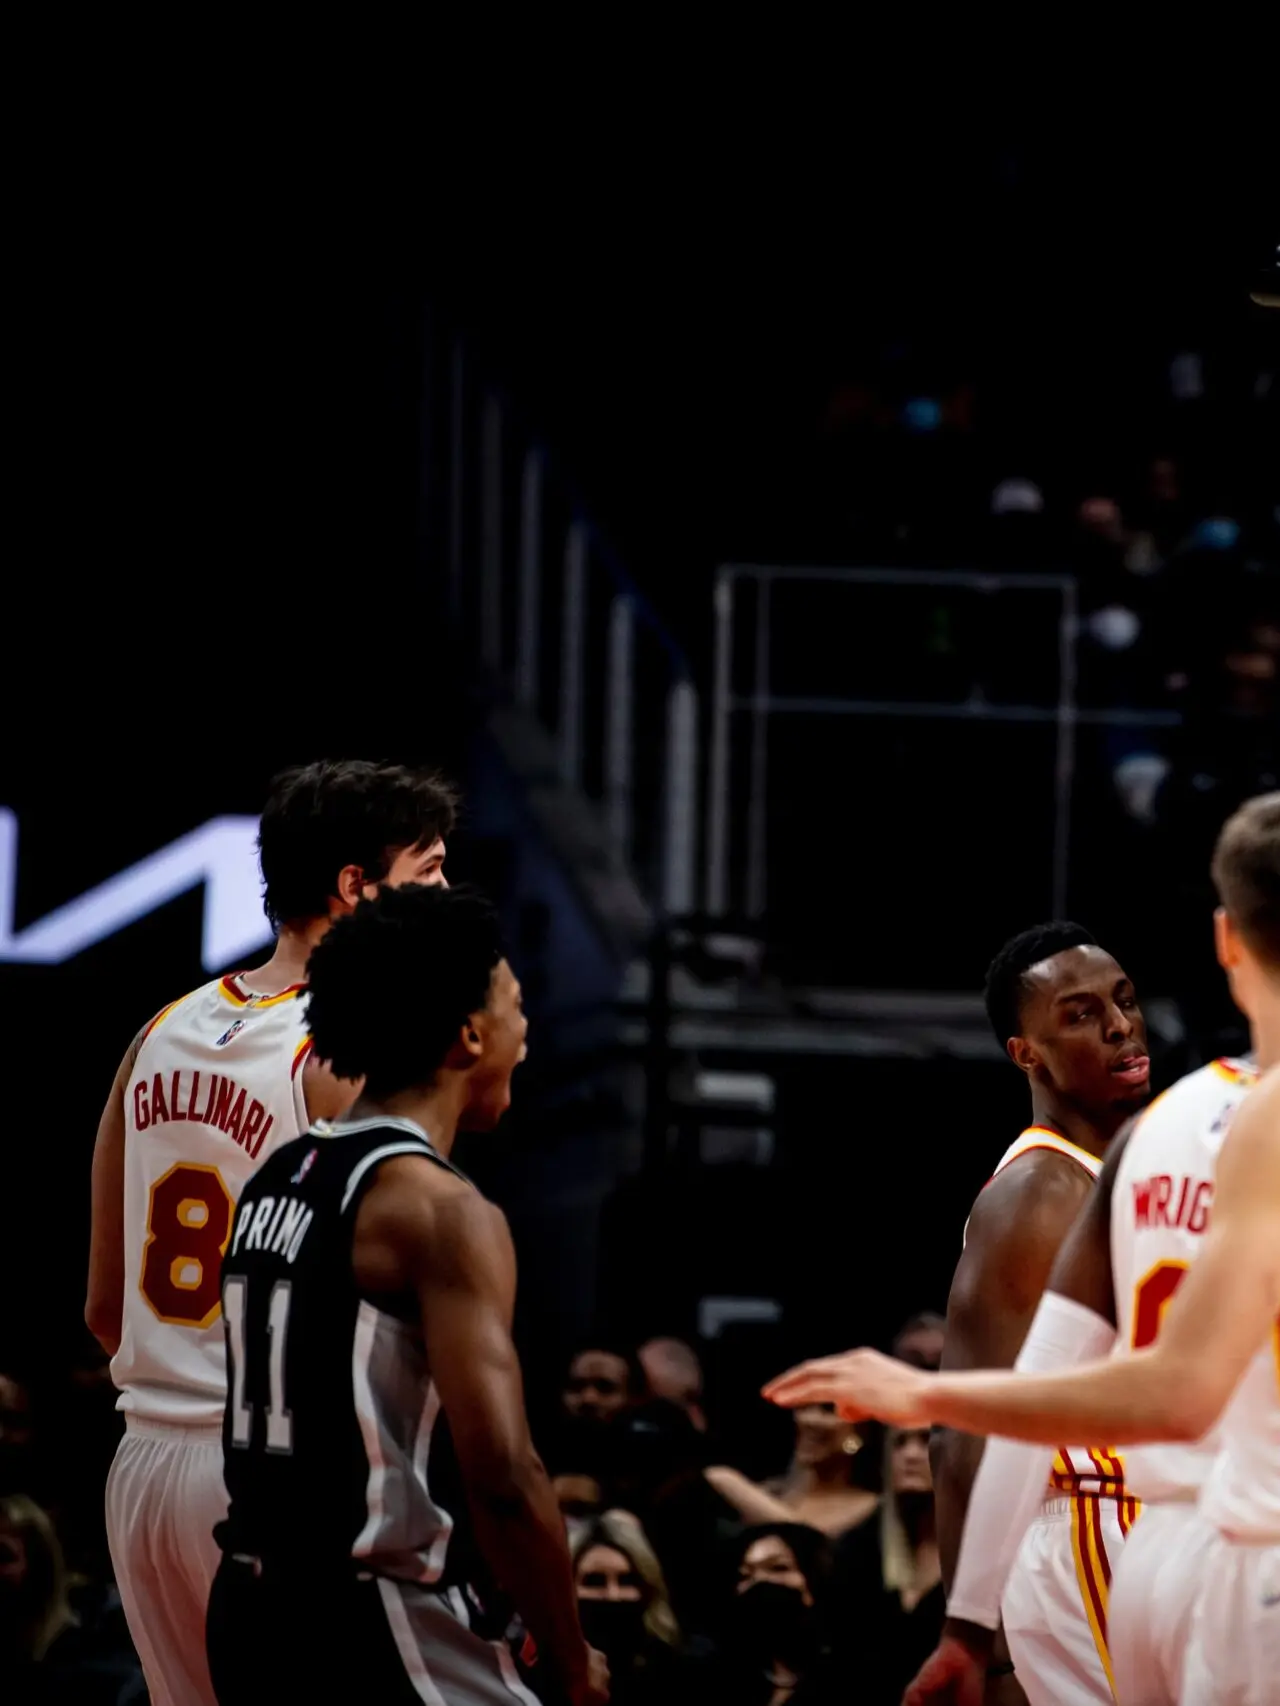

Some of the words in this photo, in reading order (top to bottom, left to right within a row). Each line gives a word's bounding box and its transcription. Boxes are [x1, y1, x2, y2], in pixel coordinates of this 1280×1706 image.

[134, 1070, 274, 1160] GALLINARI
[139, 1161, 236, 1329] 8
[231, 1195, 314, 1264] PRIMO
[222, 1275, 294, 1455] 11
